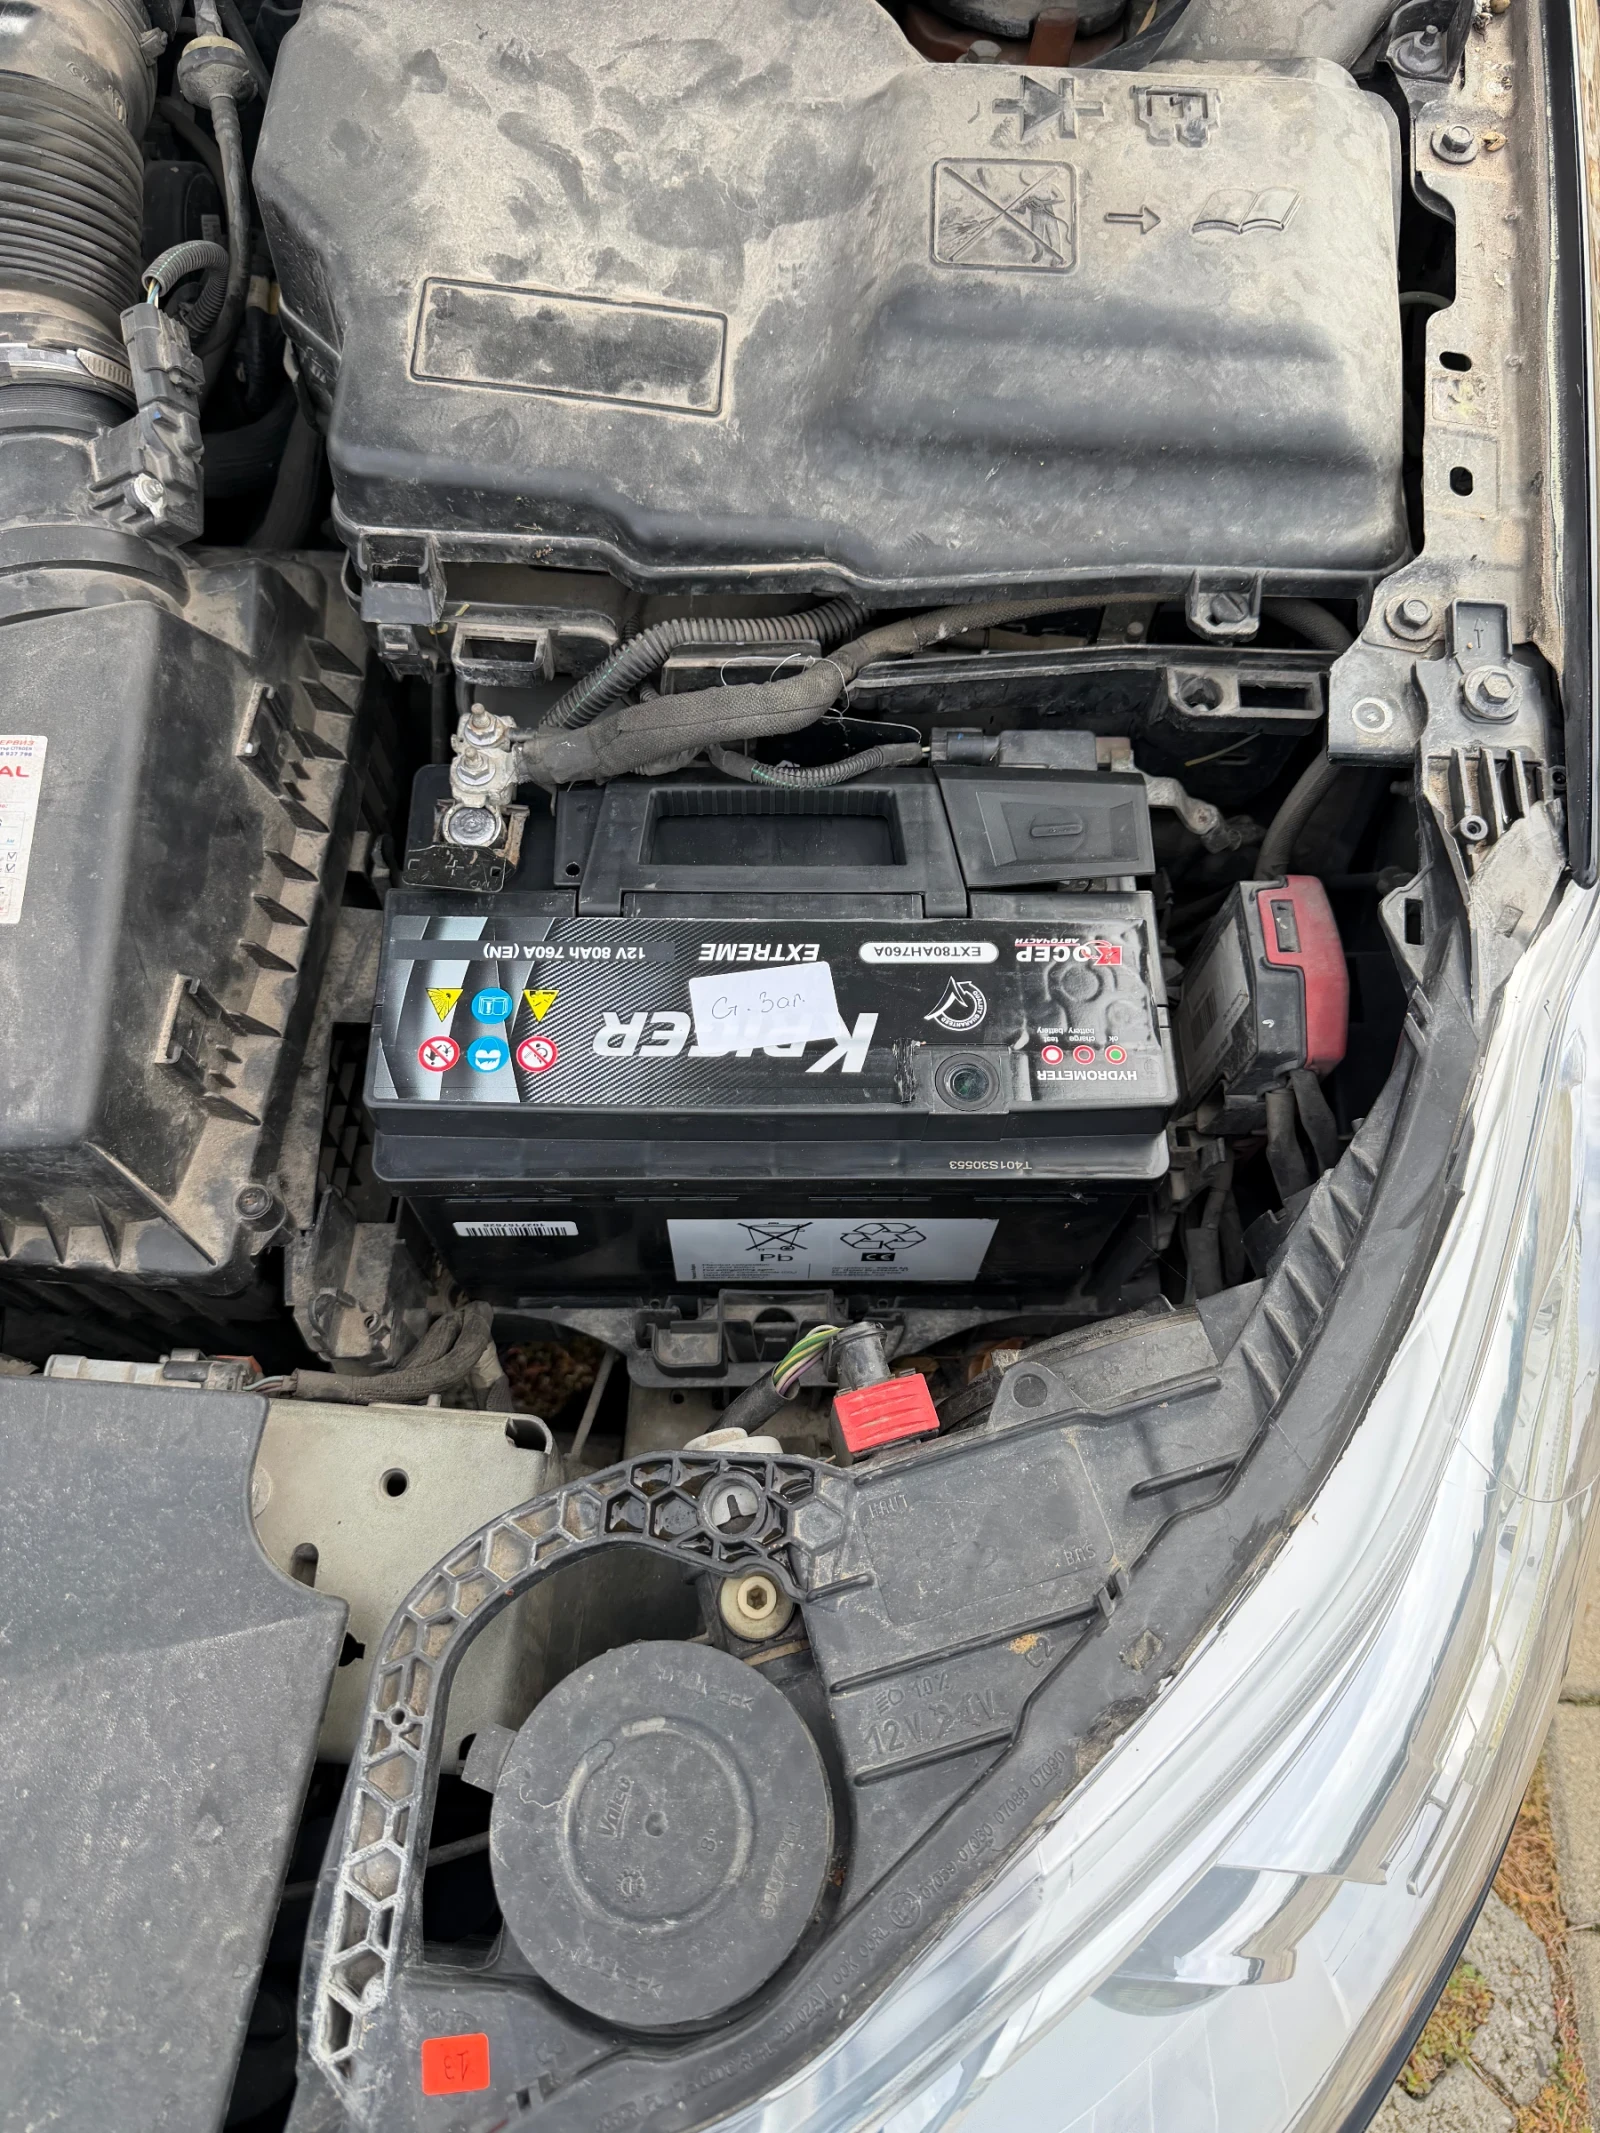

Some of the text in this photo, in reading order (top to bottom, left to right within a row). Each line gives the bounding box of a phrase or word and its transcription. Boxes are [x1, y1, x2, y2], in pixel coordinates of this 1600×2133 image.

[483, 942, 646, 960] 12V 80Ah 760A (EN)
[698, 943, 820, 962] EXTREME
[874, 945, 982, 958] EXT80AH760A
[1036, 1027, 1064, 1036] battery
[1067, 1027, 1095, 1036] battery
[1042, 1035, 1059, 1043] test
[1068, 1035, 1096, 1044] charge
[1108, 1035, 1119, 1043] ok
[1036, 1070, 1138, 1081] HYDROMETER
[948, 1160, 1033, 1171] T401S30553
[759, 1252, 794, 1263] Pb
[868, 1494, 909, 1519] HAUT
[1063, 1542, 1097, 1566] BAS
[863, 1711, 923, 1755] 12V
[1029, 1749, 1066, 1788] 07090
[598, 1776, 633, 1839] Valeo
